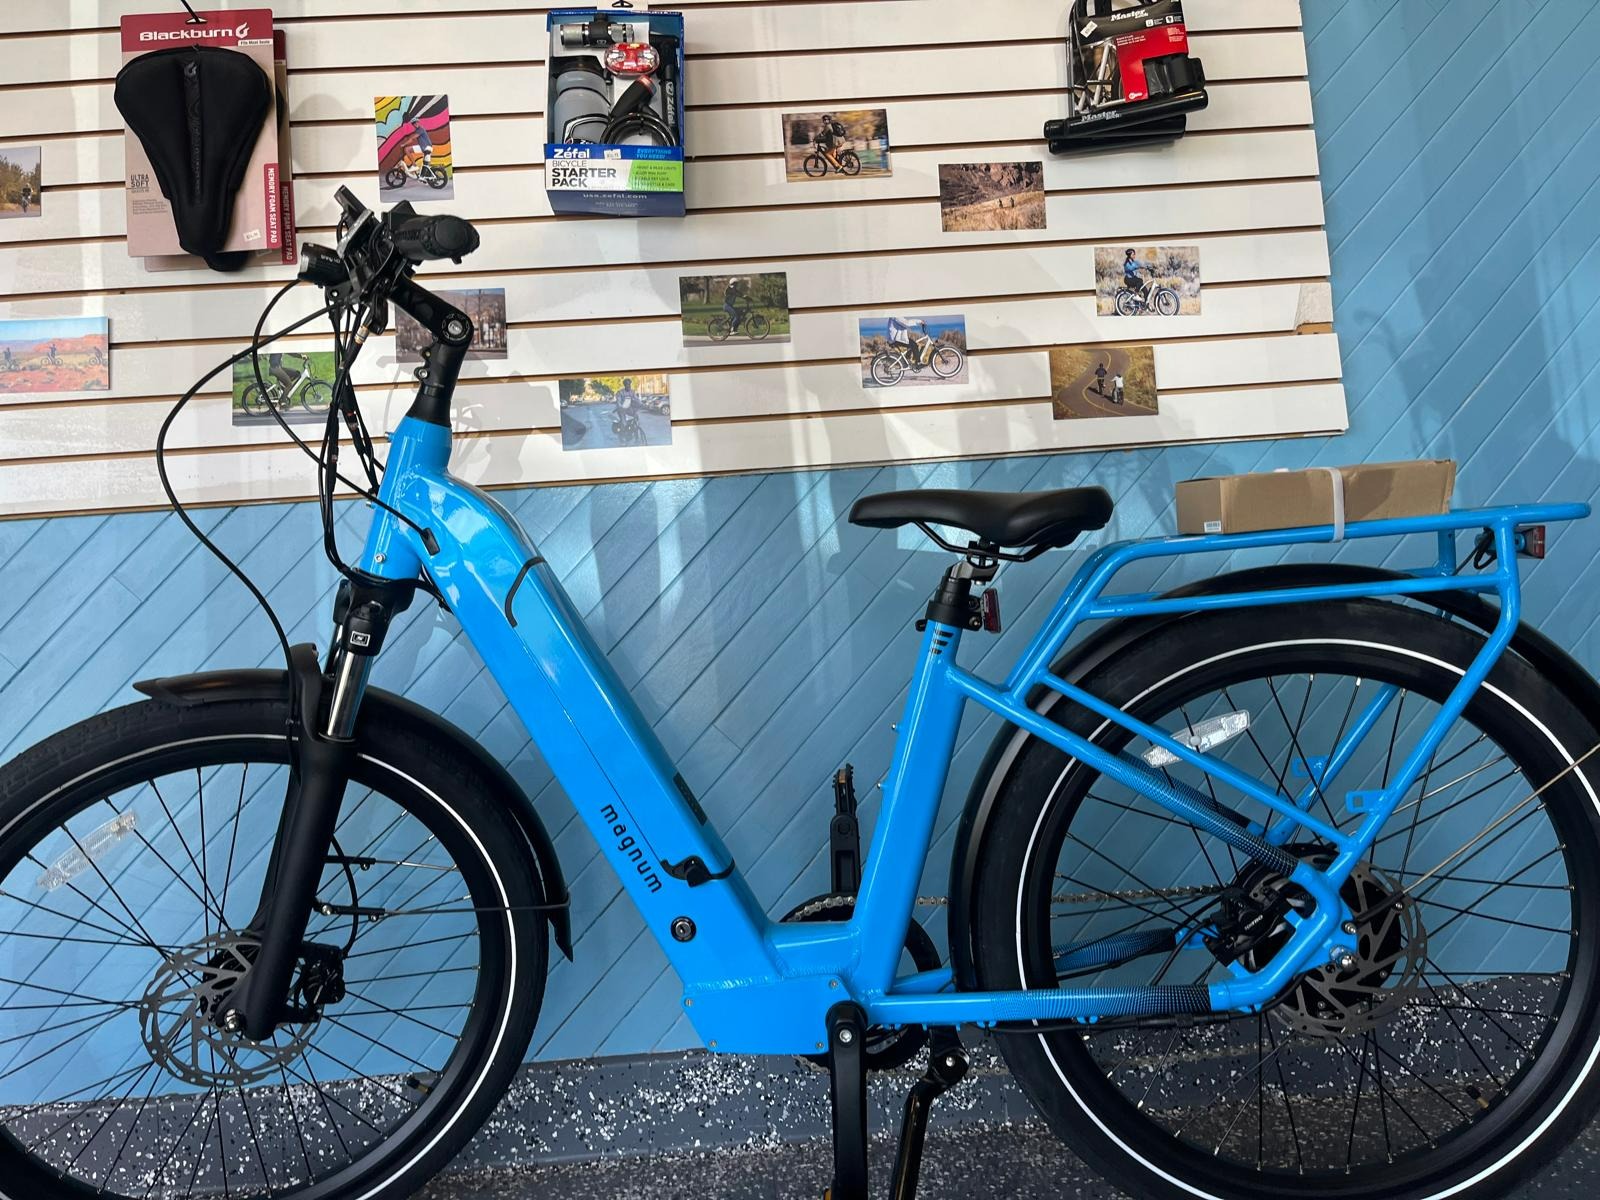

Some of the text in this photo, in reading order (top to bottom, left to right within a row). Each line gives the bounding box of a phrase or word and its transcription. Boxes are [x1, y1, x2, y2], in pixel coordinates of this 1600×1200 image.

[1110, 9, 1146, 21] Master
[140, 29, 233, 40] Blackburn
[553, 147, 590, 159] Zéfal
[552, 160, 587, 168] BICYCLE
[551, 167, 617, 178] STARTER
[267, 168, 275, 194] MEMORY
[552, 178, 588, 188] PACK
[600, 804, 663, 893] magnum
